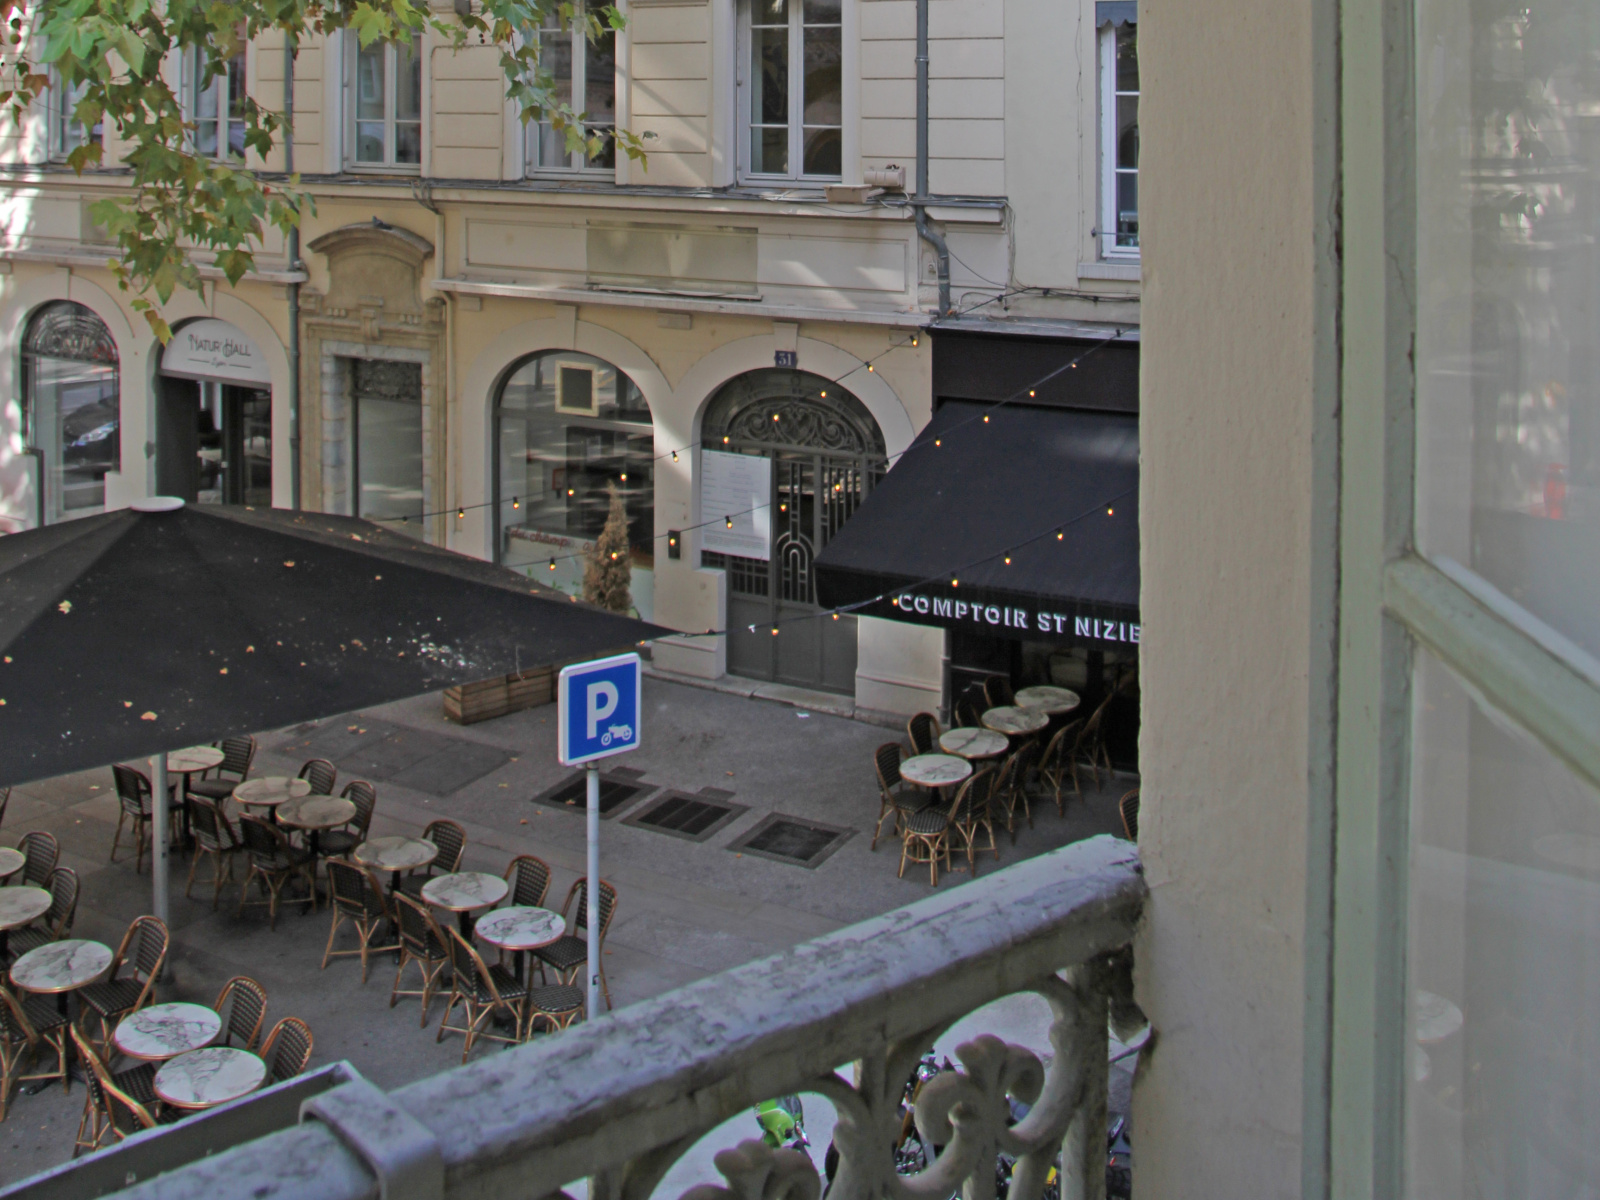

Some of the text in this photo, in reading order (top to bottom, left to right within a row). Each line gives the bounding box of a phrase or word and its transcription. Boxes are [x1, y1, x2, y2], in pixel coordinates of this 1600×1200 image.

[778, 352, 792, 366] 31
[898, 593, 1029, 630] COMPTOIR
[1037, 611, 1067, 634] ST
[586, 680, 619, 740] P
